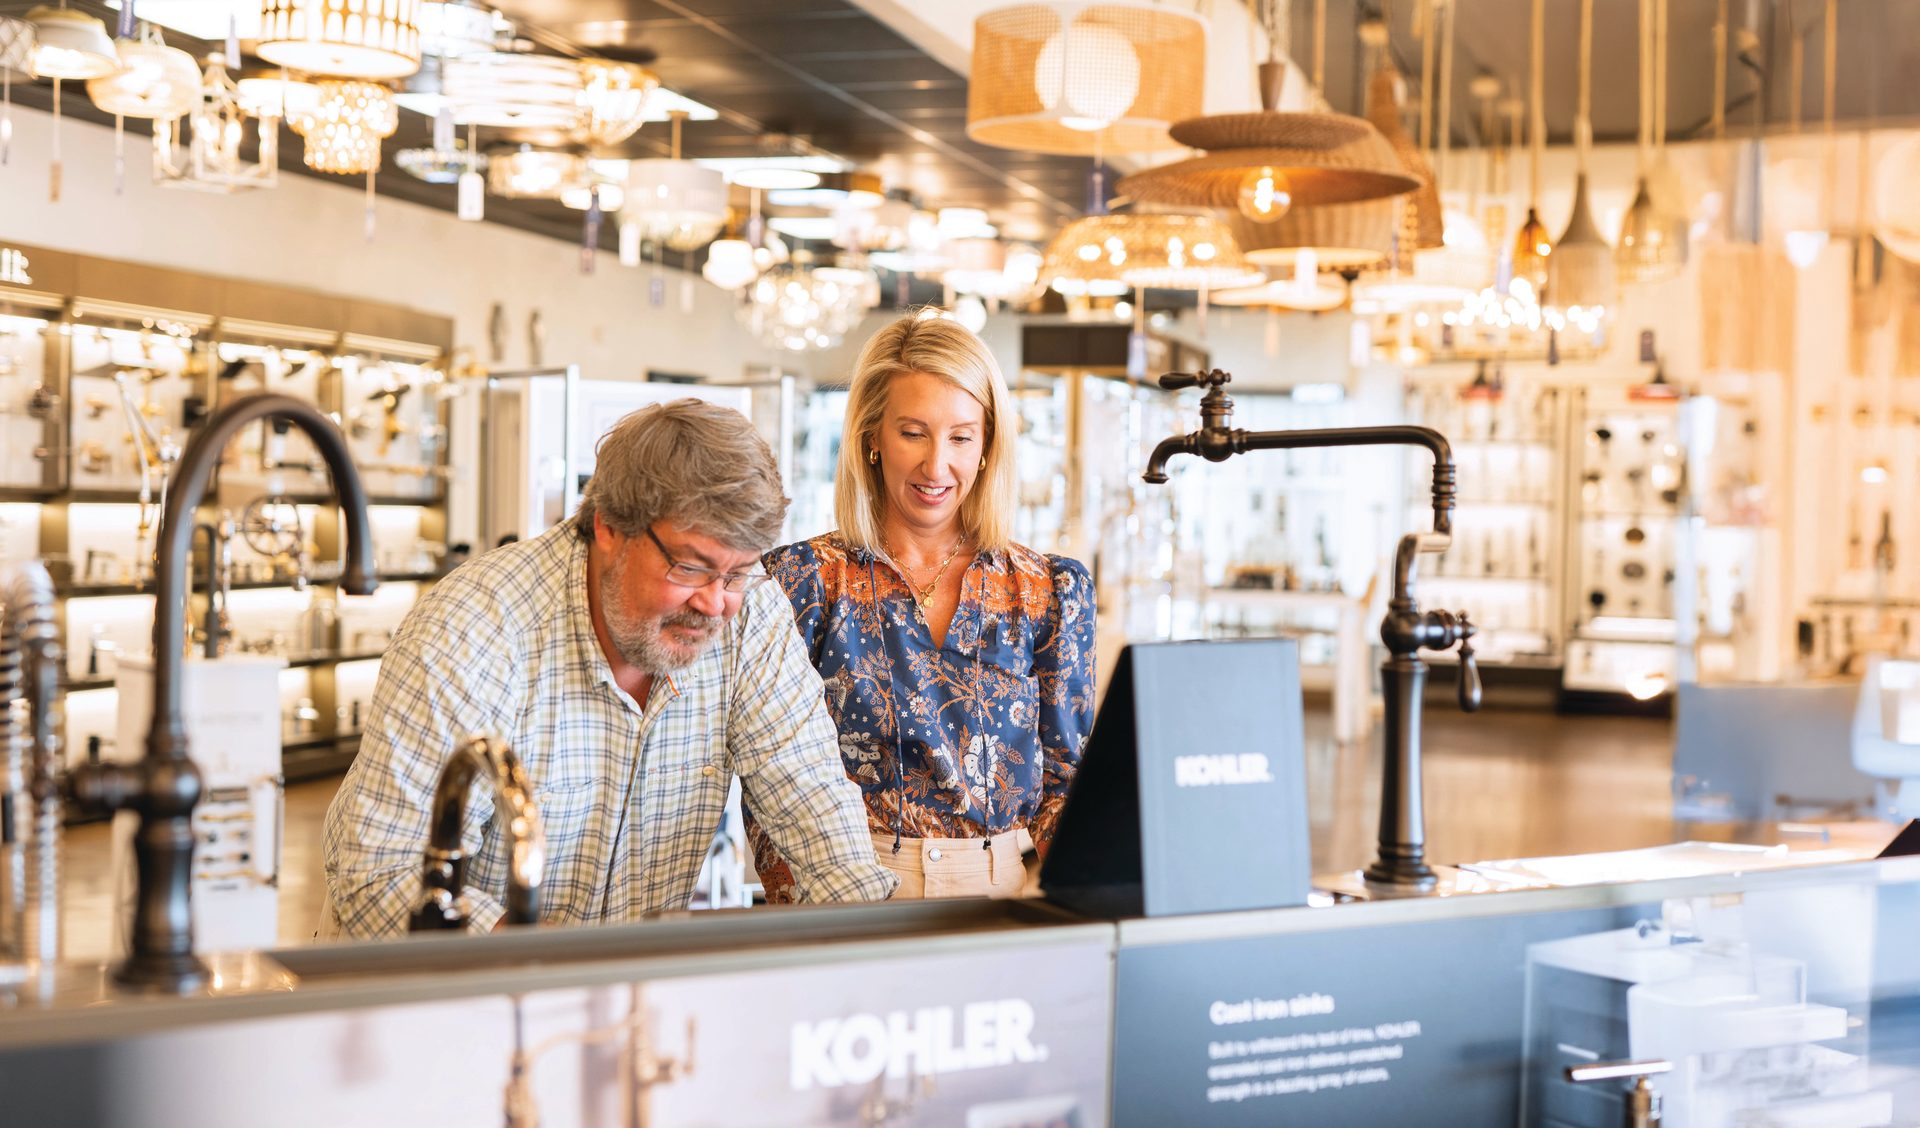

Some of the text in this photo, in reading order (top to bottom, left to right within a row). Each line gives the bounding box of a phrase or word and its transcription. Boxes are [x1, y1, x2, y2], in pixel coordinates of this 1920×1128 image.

[1209, 992, 1335, 1025] Cast iron sinks
[1234, 1041, 1248, 1057] to
[1249, 1035, 1299, 1055] withstand
[1300, 1033, 1316, 1049] the
[1263, 1058, 1284, 1074] cast
[1286, 1056, 1305, 1071] iron
[1306, 1052, 1346, 1070] delivers
[1207, 1082, 1251, 1103] strength
[1252, 1081, 1263, 1097] in
[1265, 1081, 1274, 1096] a
[1275, 1076, 1316, 1094] dazzling
[1317, 1073, 1343, 1090] array
[1343, 1069, 1356, 1086] of
